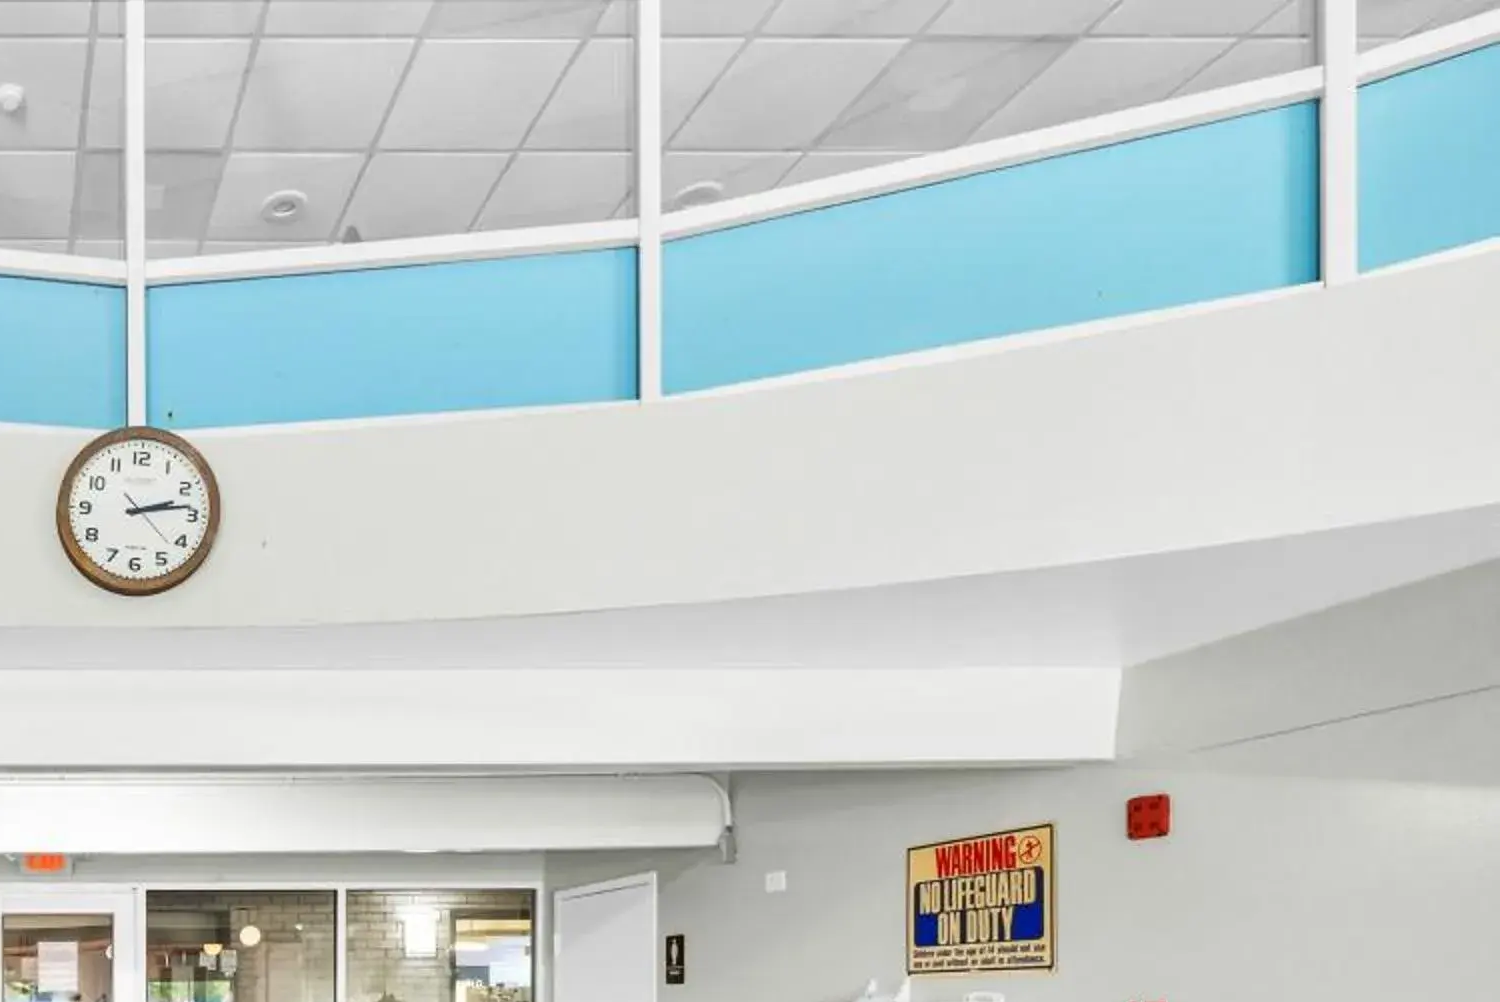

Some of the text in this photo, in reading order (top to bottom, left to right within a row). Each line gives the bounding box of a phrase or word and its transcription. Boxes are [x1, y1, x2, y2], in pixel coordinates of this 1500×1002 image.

[110, 457, 121, 473] 11
[132, 451, 151, 467] 12
[165, 460, 171, 475] 1
[89, 475, 106, 491] 10
[179, 481, 192, 497] 2
[79, 501, 92, 515] 9
[187, 508, 199, 523] 3
[85, 527, 99, 542] 8
[174, 534, 188, 549] 4
[106, 547, 119, 563] 7
[155, 551, 168, 566] 5
[128, 557, 141, 572] 6
[935, 835, 1017, 878] WARNING
[919, 869, 1036, 915] NO LIFEGUARD
[937, 906, 1015, 945] ON DUTY
